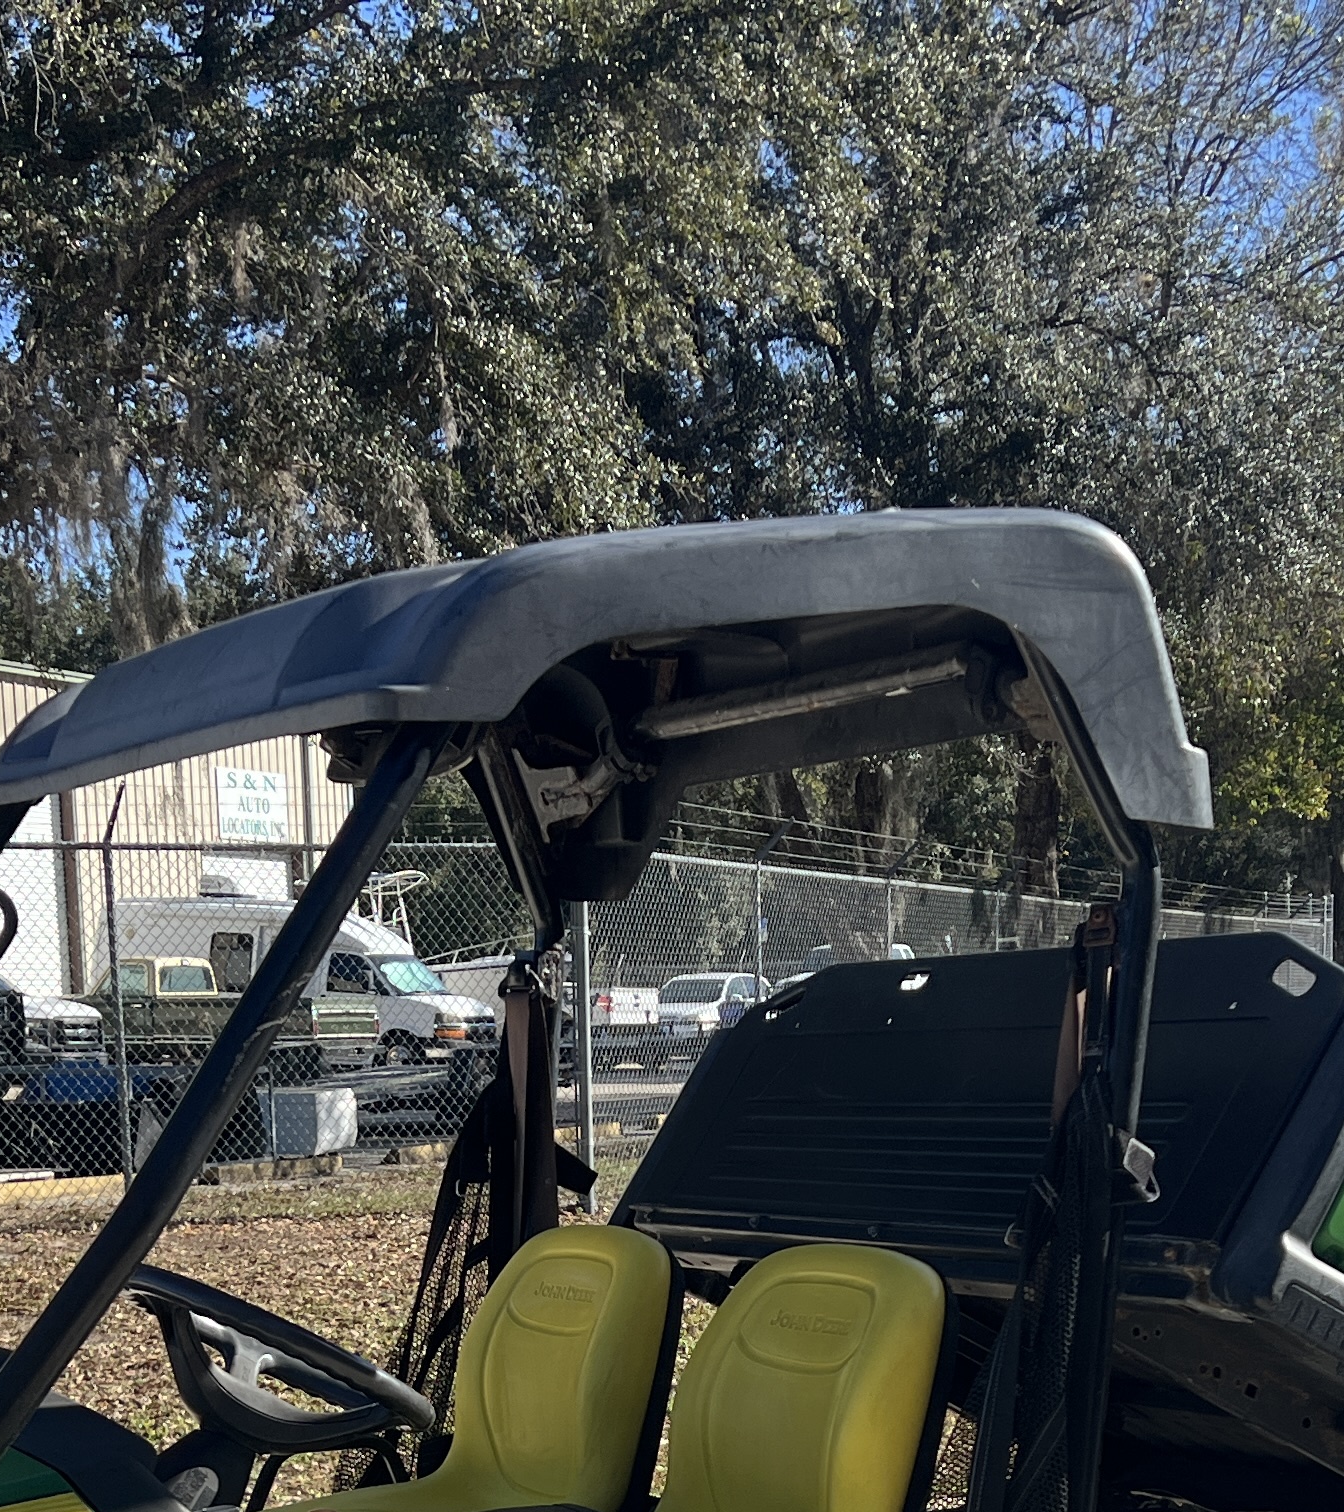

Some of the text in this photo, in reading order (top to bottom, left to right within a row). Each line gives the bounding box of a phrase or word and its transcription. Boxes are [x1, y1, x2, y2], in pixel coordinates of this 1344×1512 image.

[227, 771, 277, 792] S & N
[237, 796, 271, 814] AUTO
[534, 1281, 567, 1300] JOHN
